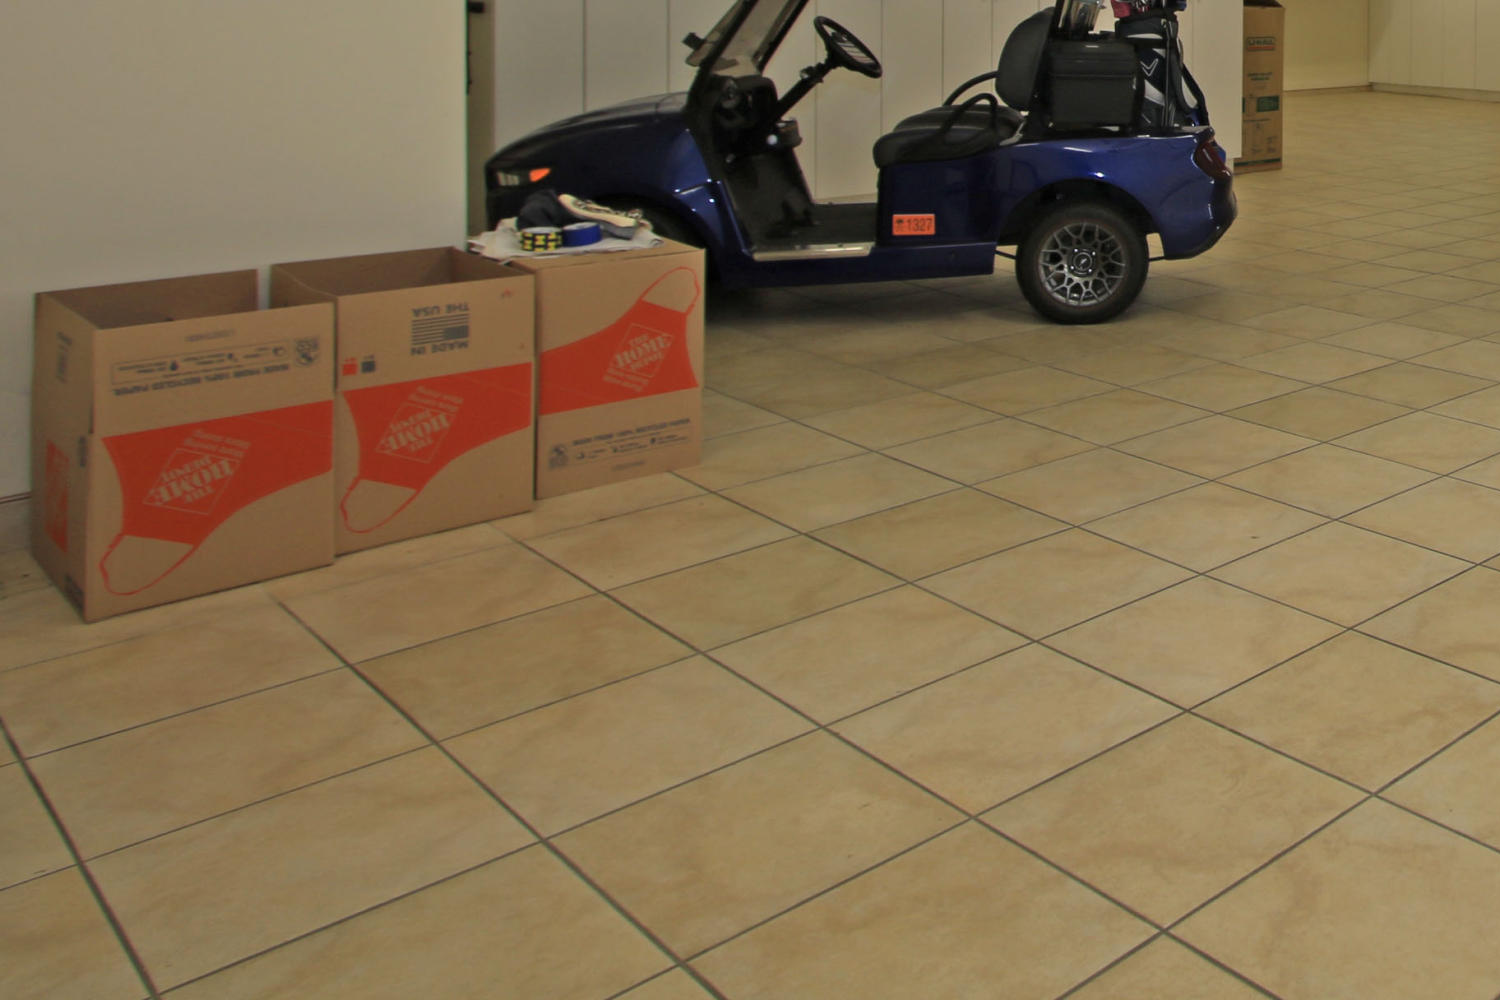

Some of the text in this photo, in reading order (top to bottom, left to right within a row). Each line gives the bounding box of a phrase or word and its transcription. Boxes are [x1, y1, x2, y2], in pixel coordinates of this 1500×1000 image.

[906, 218, 932, 232] 1327
[412, 303, 469, 317] THE USA
[410, 340, 469, 357] MADE IN
[614, 336, 671, 368] HOME
[380, 413, 450, 451] HOME
[160, 455, 212, 482] DEPOT
[147, 459, 233, 506] HOME
[184, 486, 215, 504] THE
